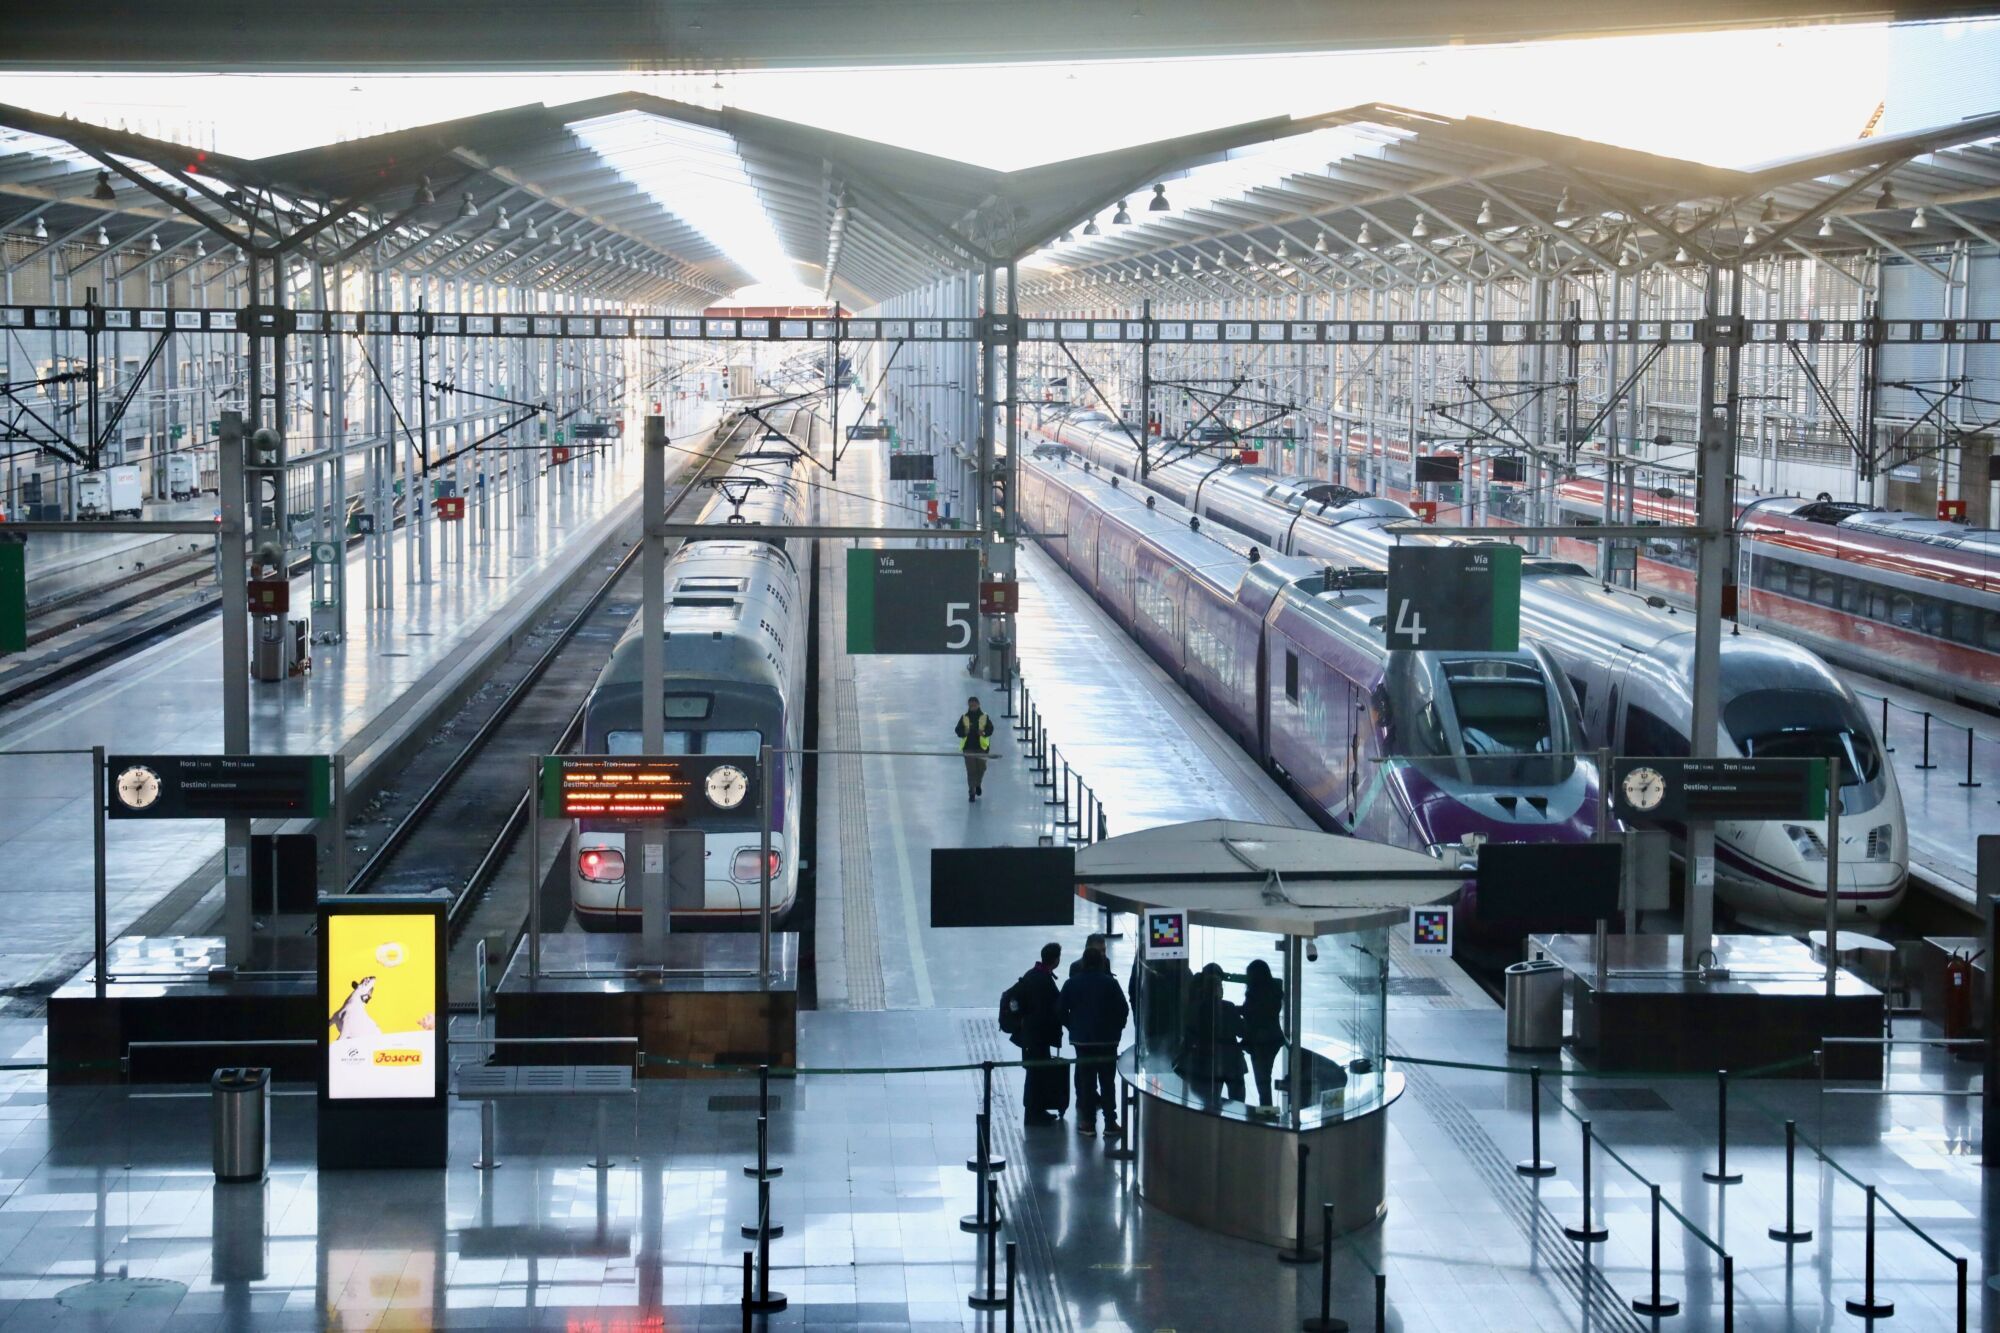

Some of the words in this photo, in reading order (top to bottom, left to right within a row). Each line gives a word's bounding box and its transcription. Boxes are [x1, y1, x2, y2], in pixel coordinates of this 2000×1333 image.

[449, 489, 456, 498] 6
[880, 556, 895, 566] Vía
[1474, 554, 1488, 564] Vía
[946, 602, 971, 649] 5
[1395, 599, 1426, 645] 4
[563, 780, 589, 788] Destino
[376, 1053, 420, 1063] Josera
